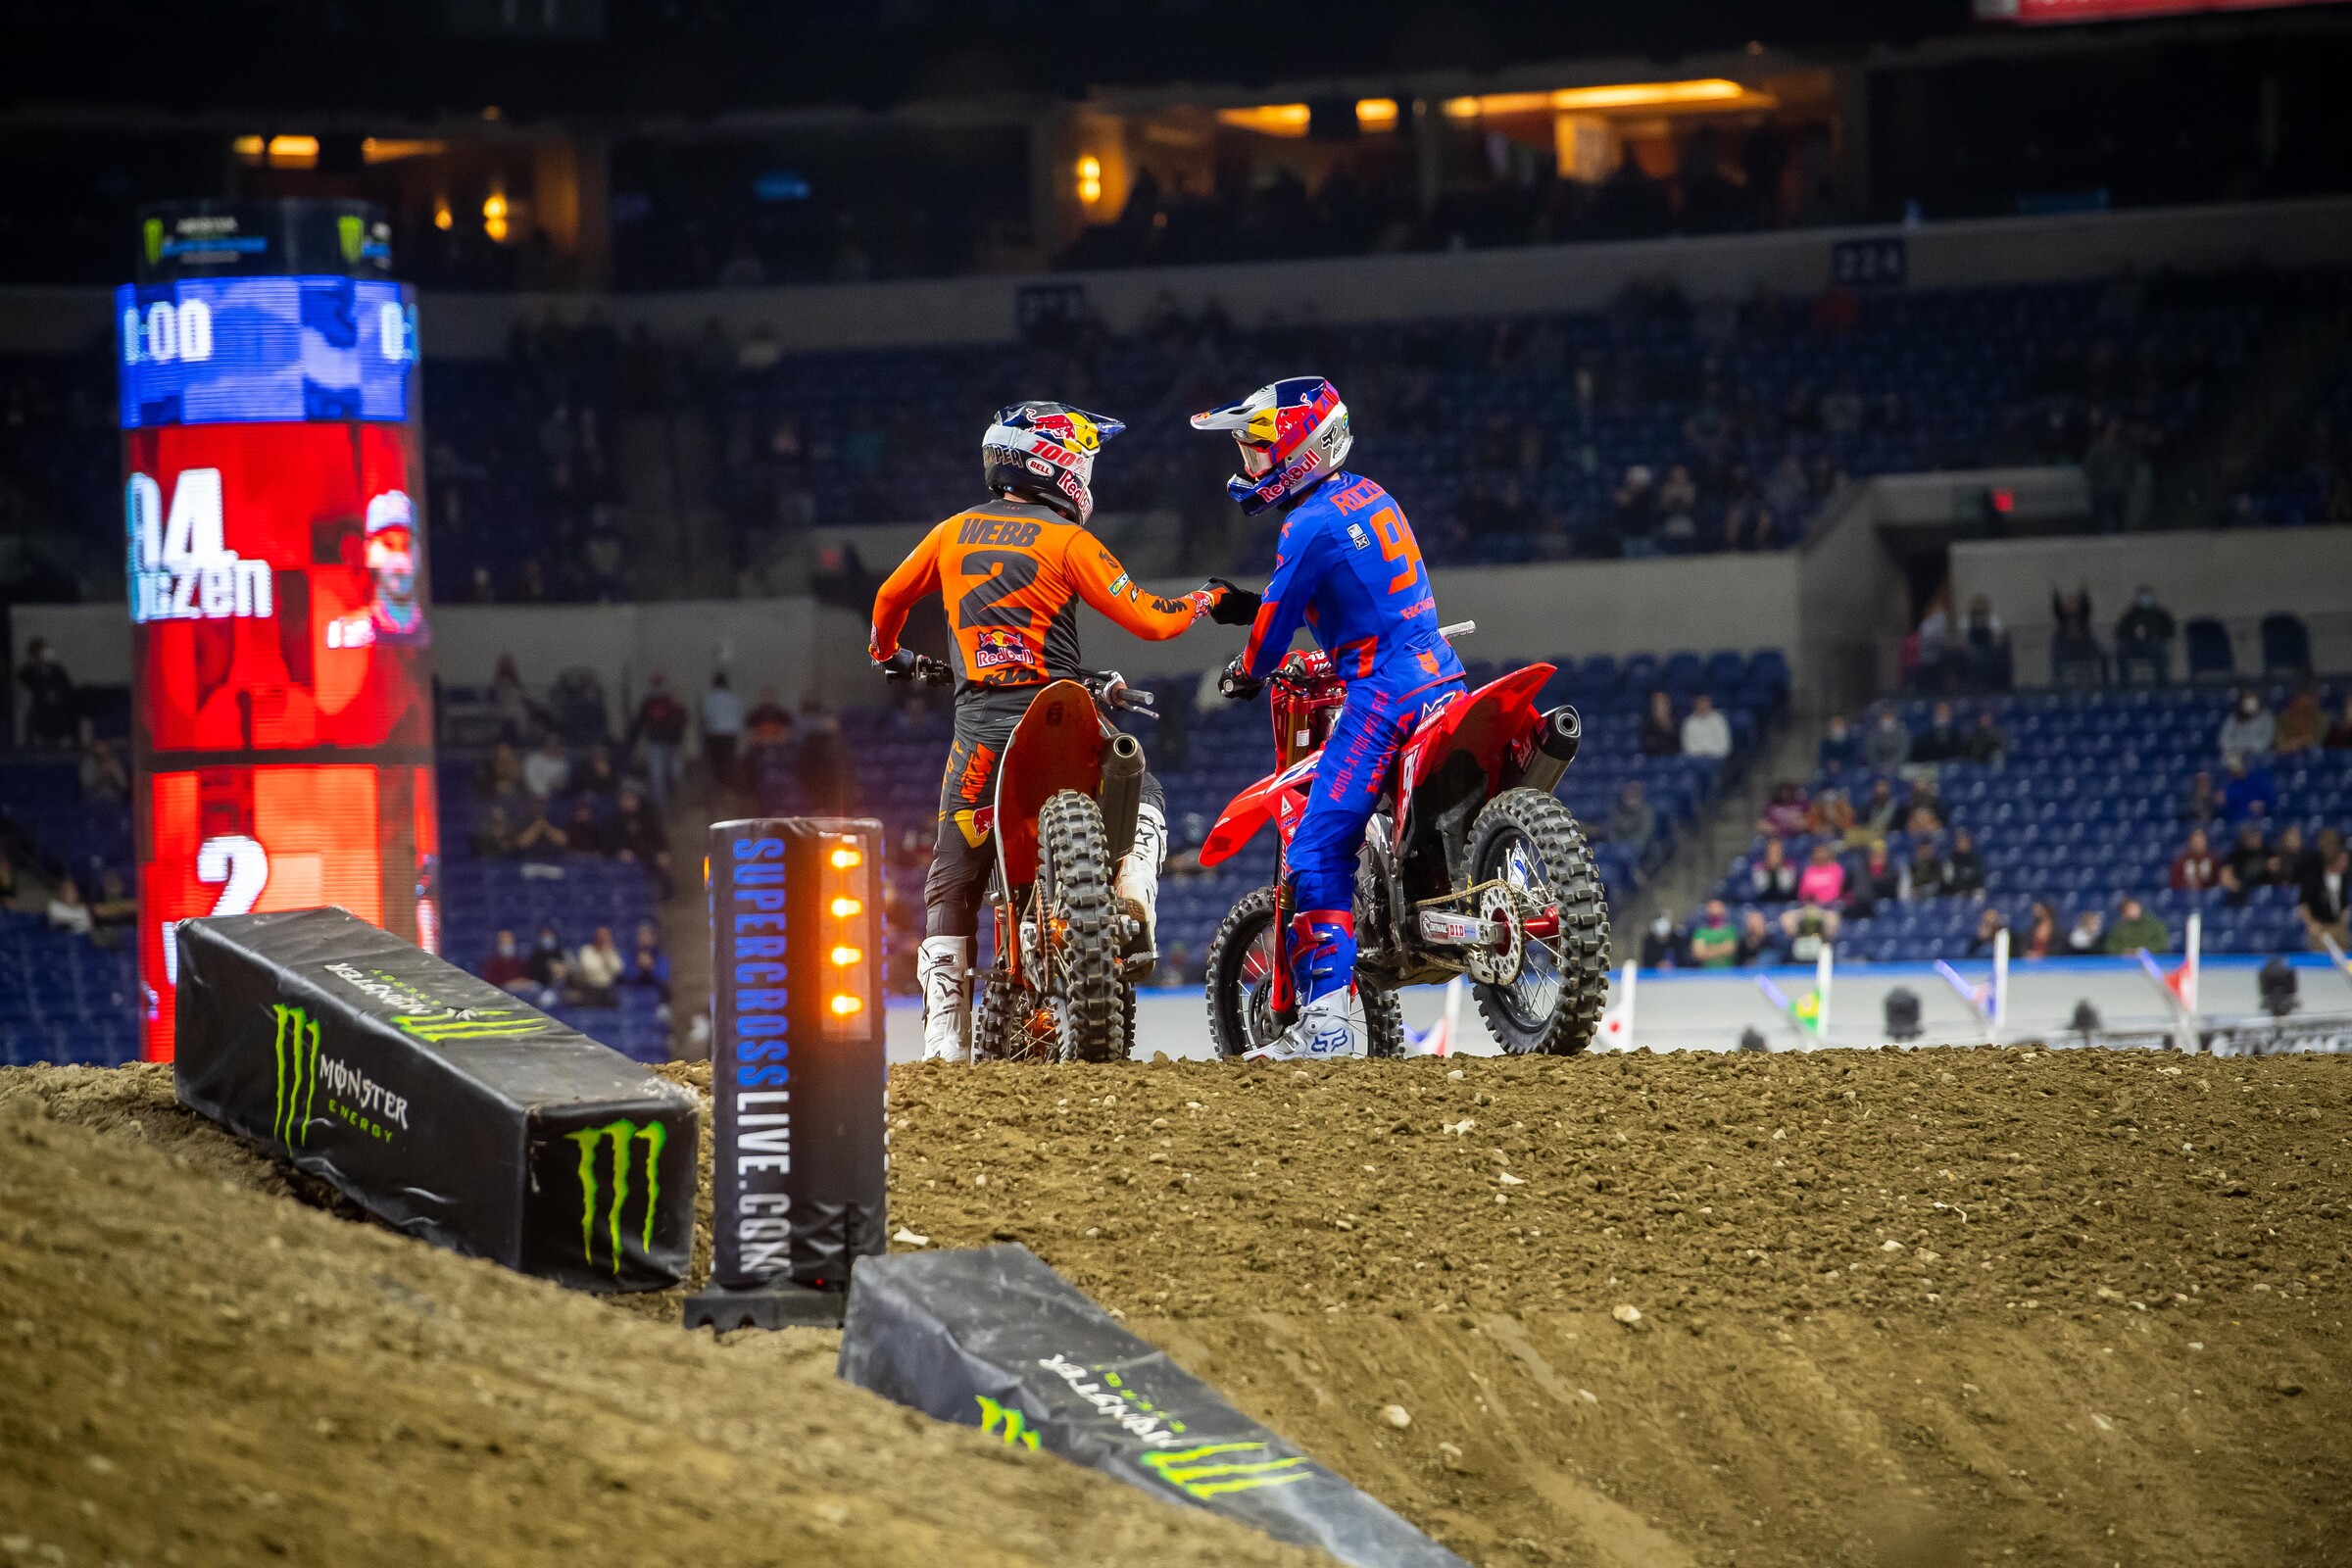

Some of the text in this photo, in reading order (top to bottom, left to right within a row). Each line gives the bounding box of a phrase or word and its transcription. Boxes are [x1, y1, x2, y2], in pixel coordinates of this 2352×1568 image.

[1030, 461, 1051, 475] BELL
[956, 517, 1042, 547] WEBB
[958, 550, 1039, 630] 2
[983, 667, 1039, 685] KTM
[328, 1099, 392, 1144] ENERGY
